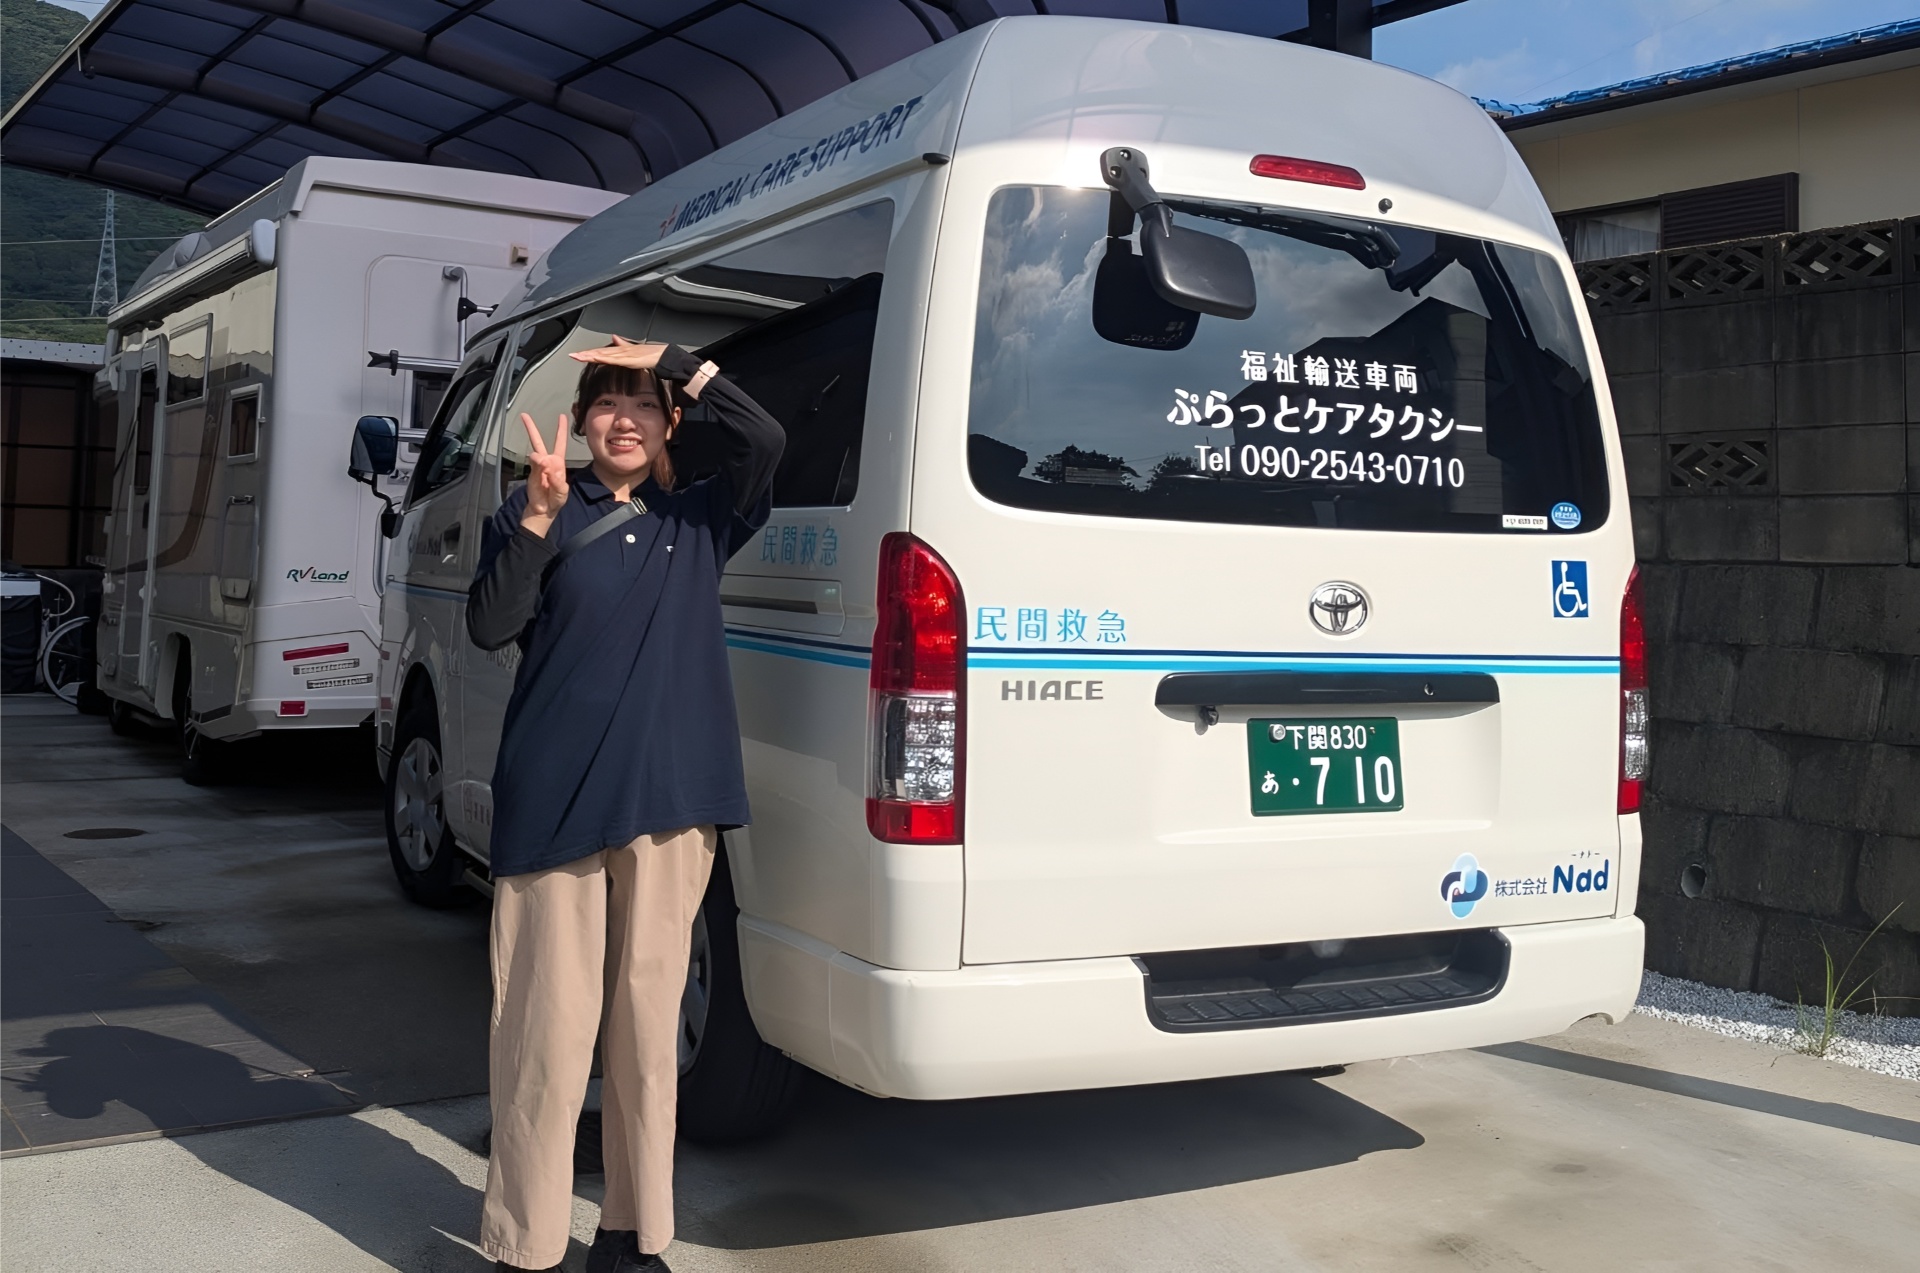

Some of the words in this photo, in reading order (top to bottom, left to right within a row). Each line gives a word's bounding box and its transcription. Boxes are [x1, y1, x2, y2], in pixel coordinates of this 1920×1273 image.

[673, 174, 749, 232] MEDICAL
[751, 147, 809, 198] CARE
[802, 95, 923, 177] SUPPORT
[1240, 349, 1418, 394] 福祉輸送車両
[1166, 388, 1484, 443] ぷらっとケアタクシー
[1194, 444, 1232, 473] Tel
[1240, 444, 1465, 488] 090-2543-0710
[760, 525, 838, 566] 民間救急
[974, 606, 1127, 643] 民間救急
[1001, 680, 1104, 701] HIACE
[1261, 770, 1280, 795] あ
[1494, 877, 1548, 897] 株式会社
[1552, 859, 1609, 894] Nad
